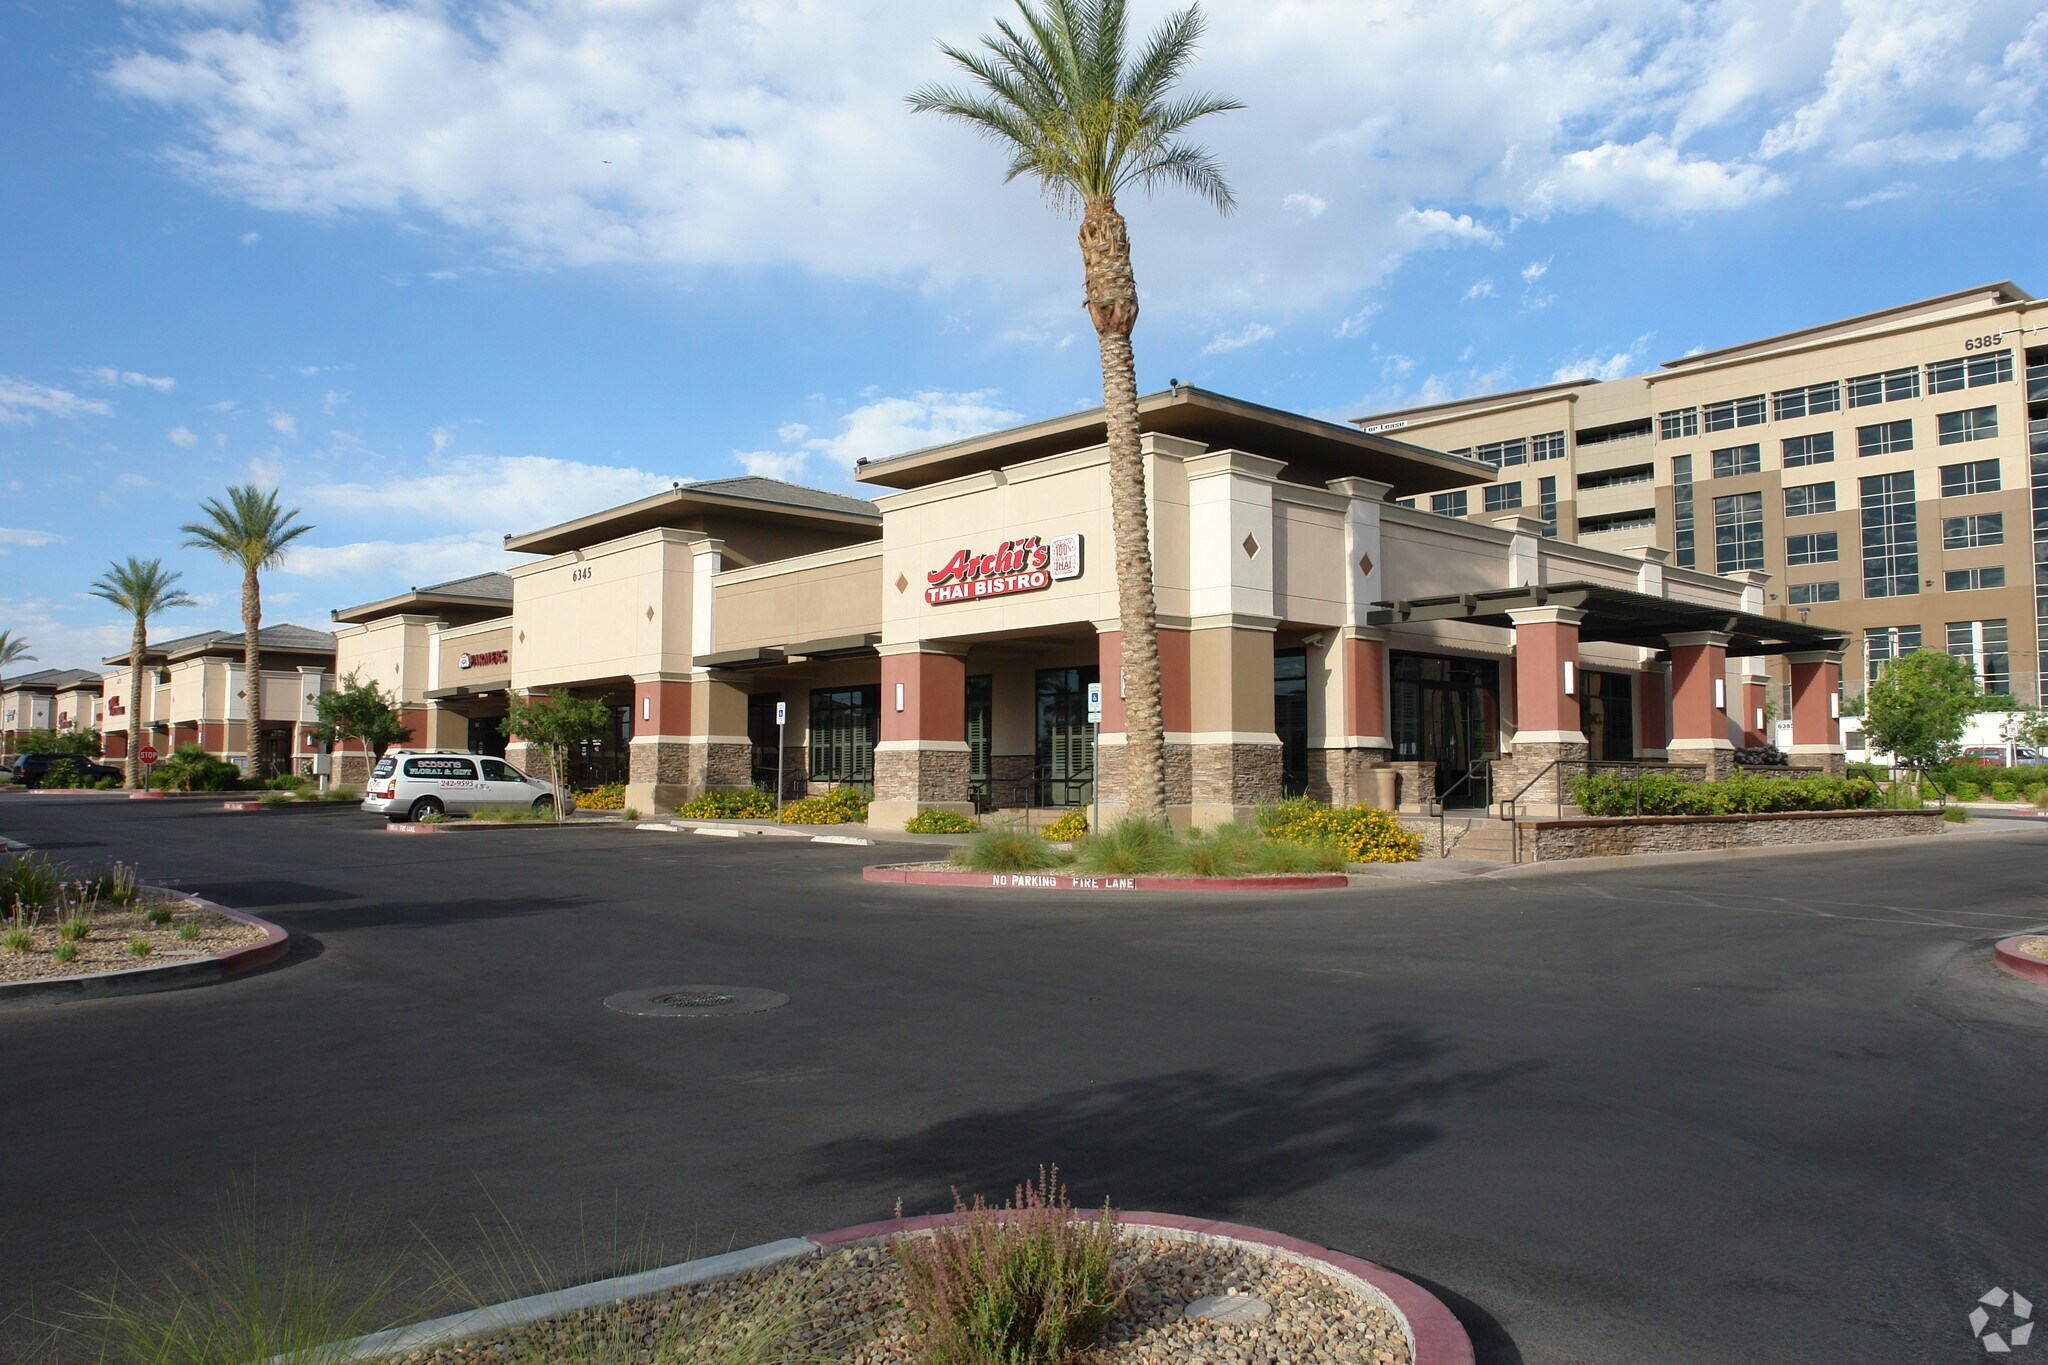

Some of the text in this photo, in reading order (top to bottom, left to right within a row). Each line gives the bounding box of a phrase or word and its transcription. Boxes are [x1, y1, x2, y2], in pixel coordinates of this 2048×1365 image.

[1965, 333, 2003, 351] 6385
[1380, 422, 1405, 430] Lease
[927, 536, 1048, 584] Archi's
[572, 566, 592, 582] 6345
[927, 571, 1045, 602] THAI BISTRO
[140, 751, 158, 759] STOP
[409, 767, 443, 775] FLORAL
[992, 874, 1134, 889] NO PARKING FIRE LANE
